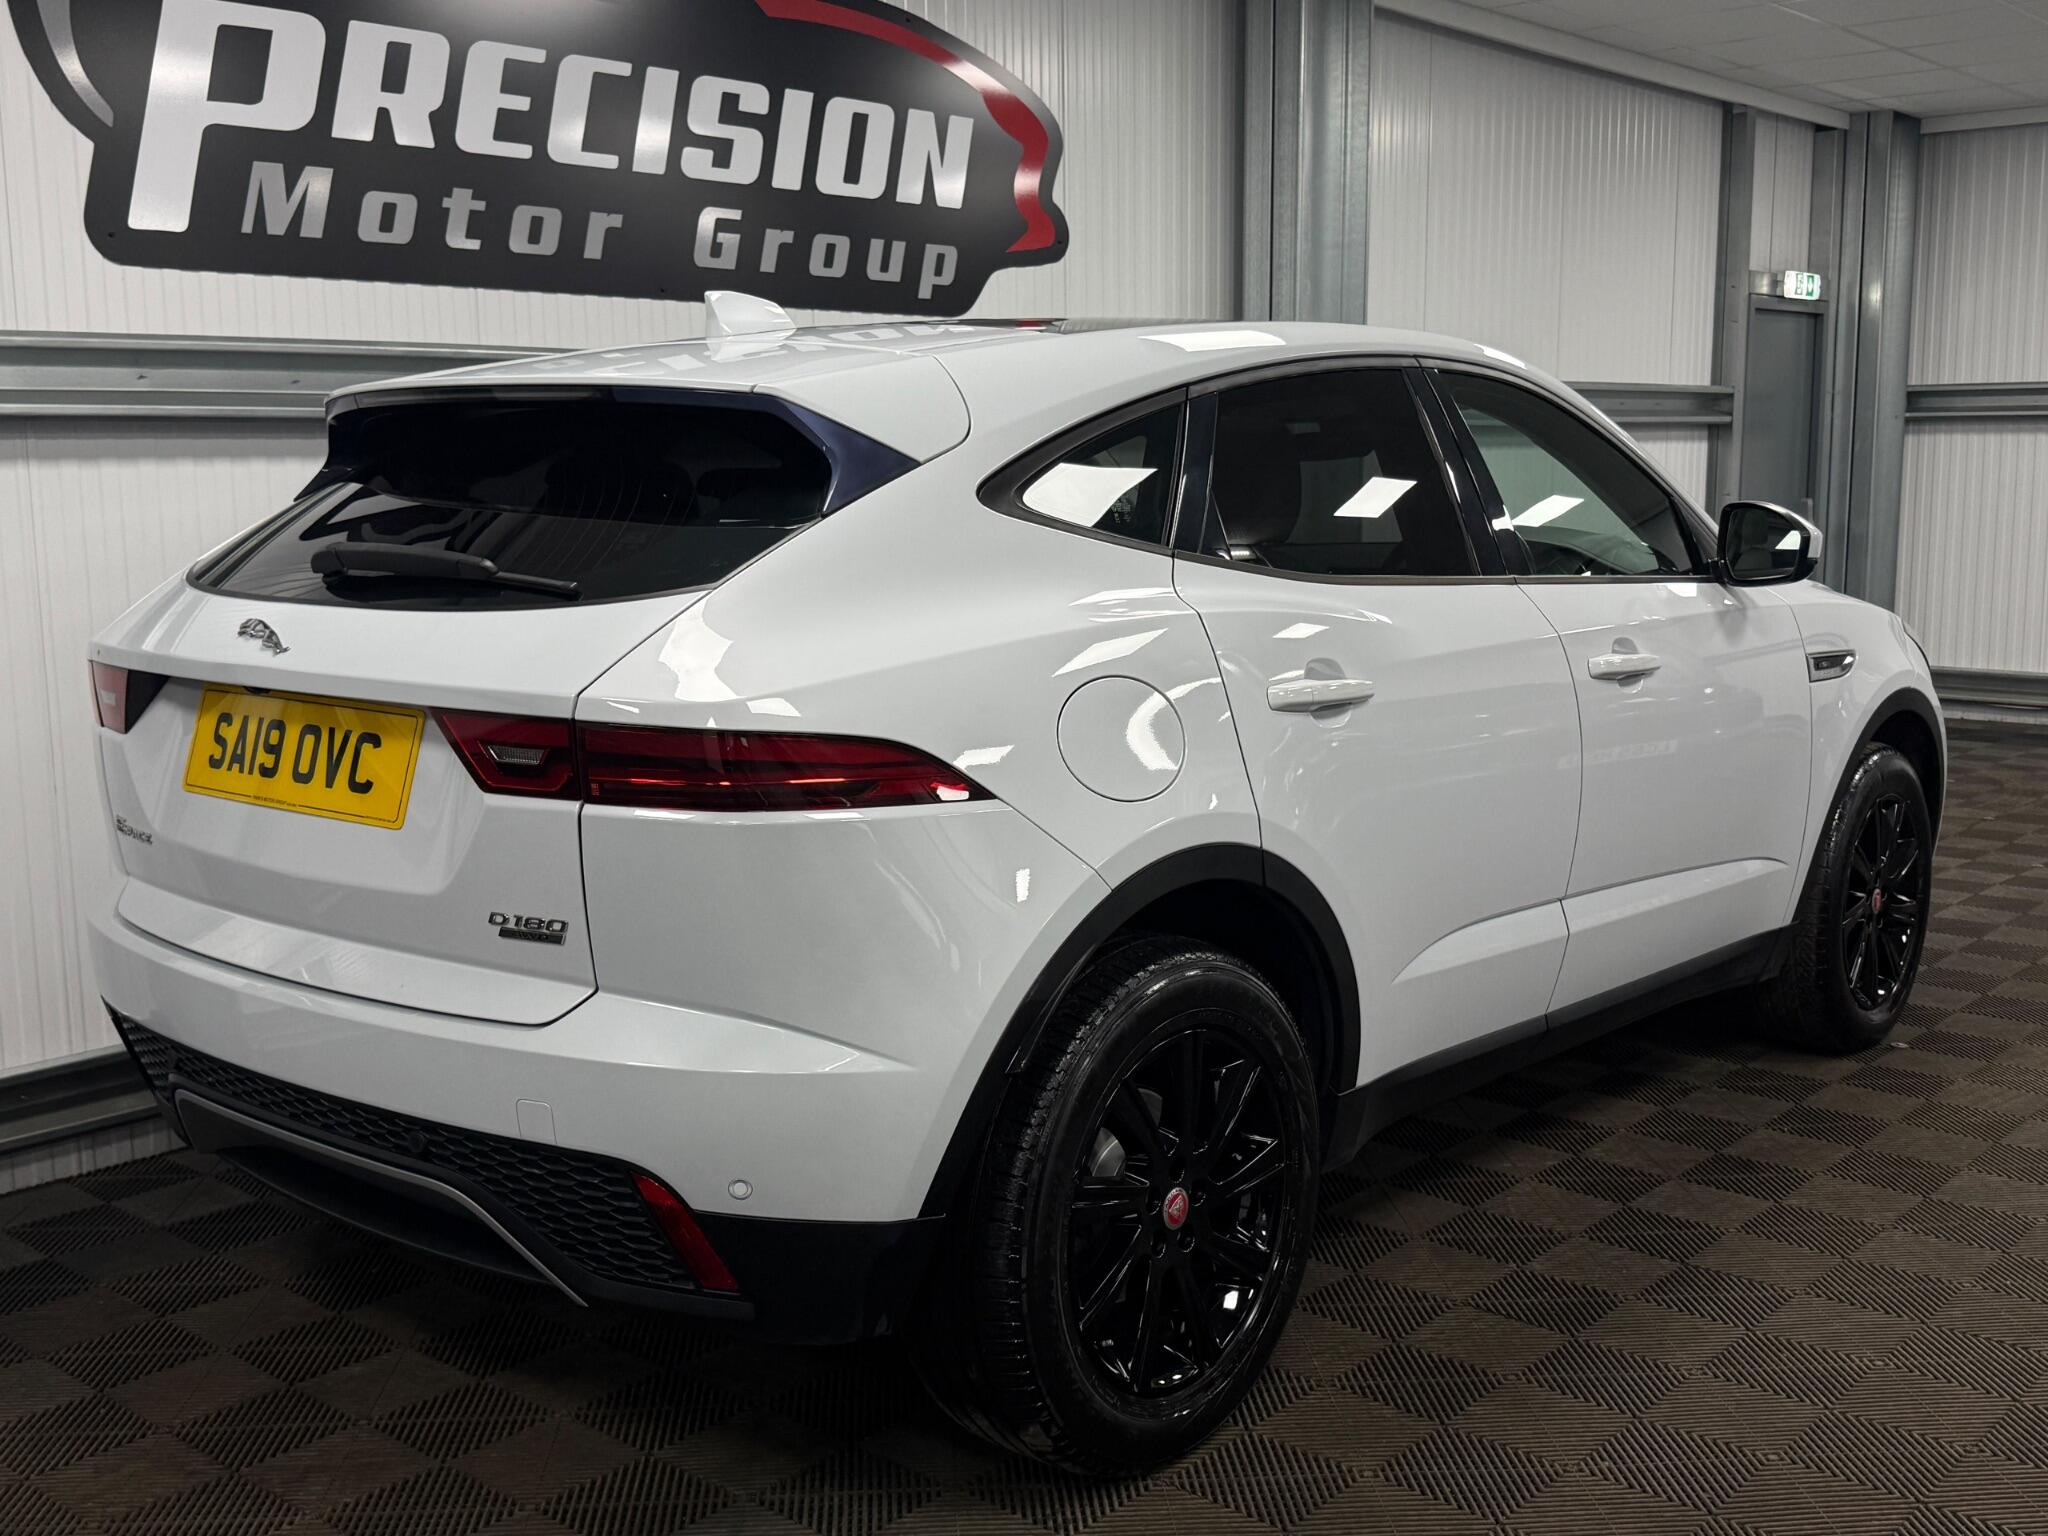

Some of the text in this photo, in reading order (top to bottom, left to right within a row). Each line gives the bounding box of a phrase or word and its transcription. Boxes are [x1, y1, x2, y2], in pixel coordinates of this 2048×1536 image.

[128, 0, 974, 232] PRECISION
[241, 161, 958, 299] Motor Group
[208, 711, 382, 794] SA19 OVC
[488, 911, 568, 933] D180
